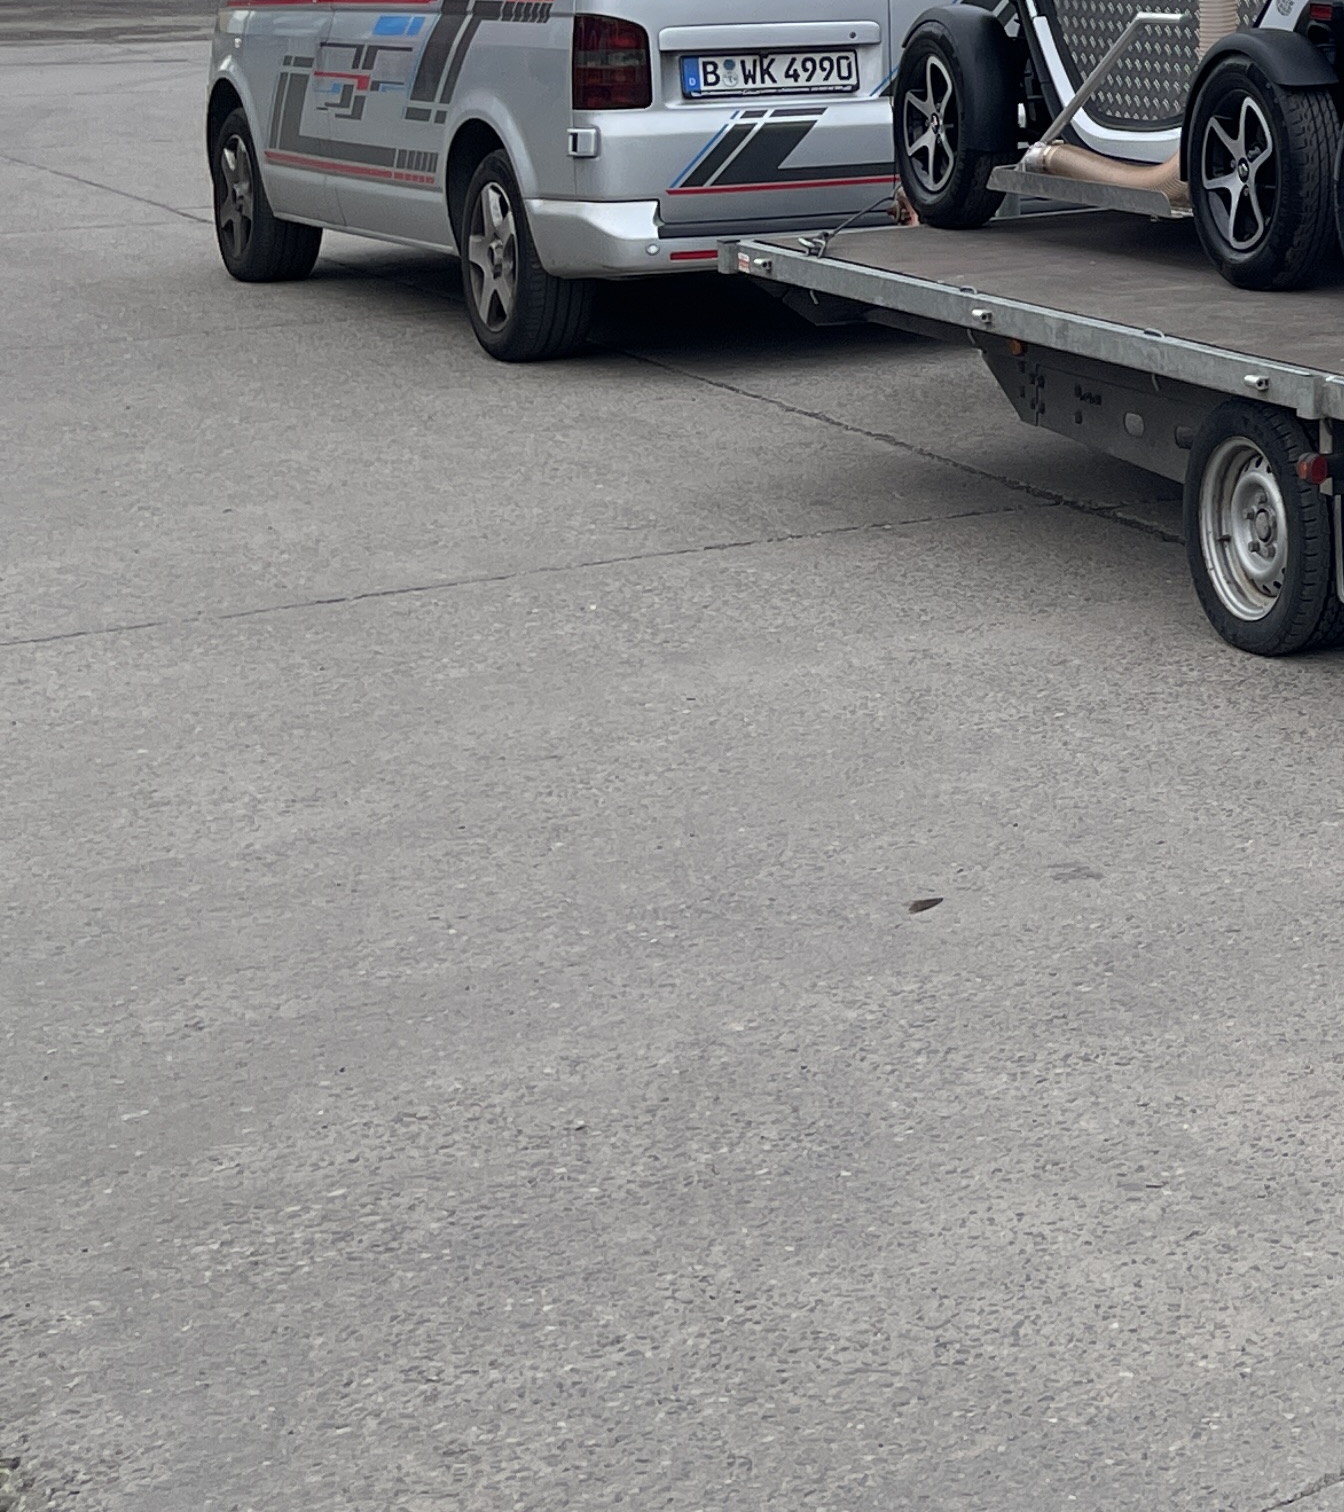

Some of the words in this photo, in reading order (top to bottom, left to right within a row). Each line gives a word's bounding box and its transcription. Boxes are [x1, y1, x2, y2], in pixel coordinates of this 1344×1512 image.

[702, 60, 721, 87] B
[740, 57, 777, 85] WK
[784, 55, 853, 83] 4990
